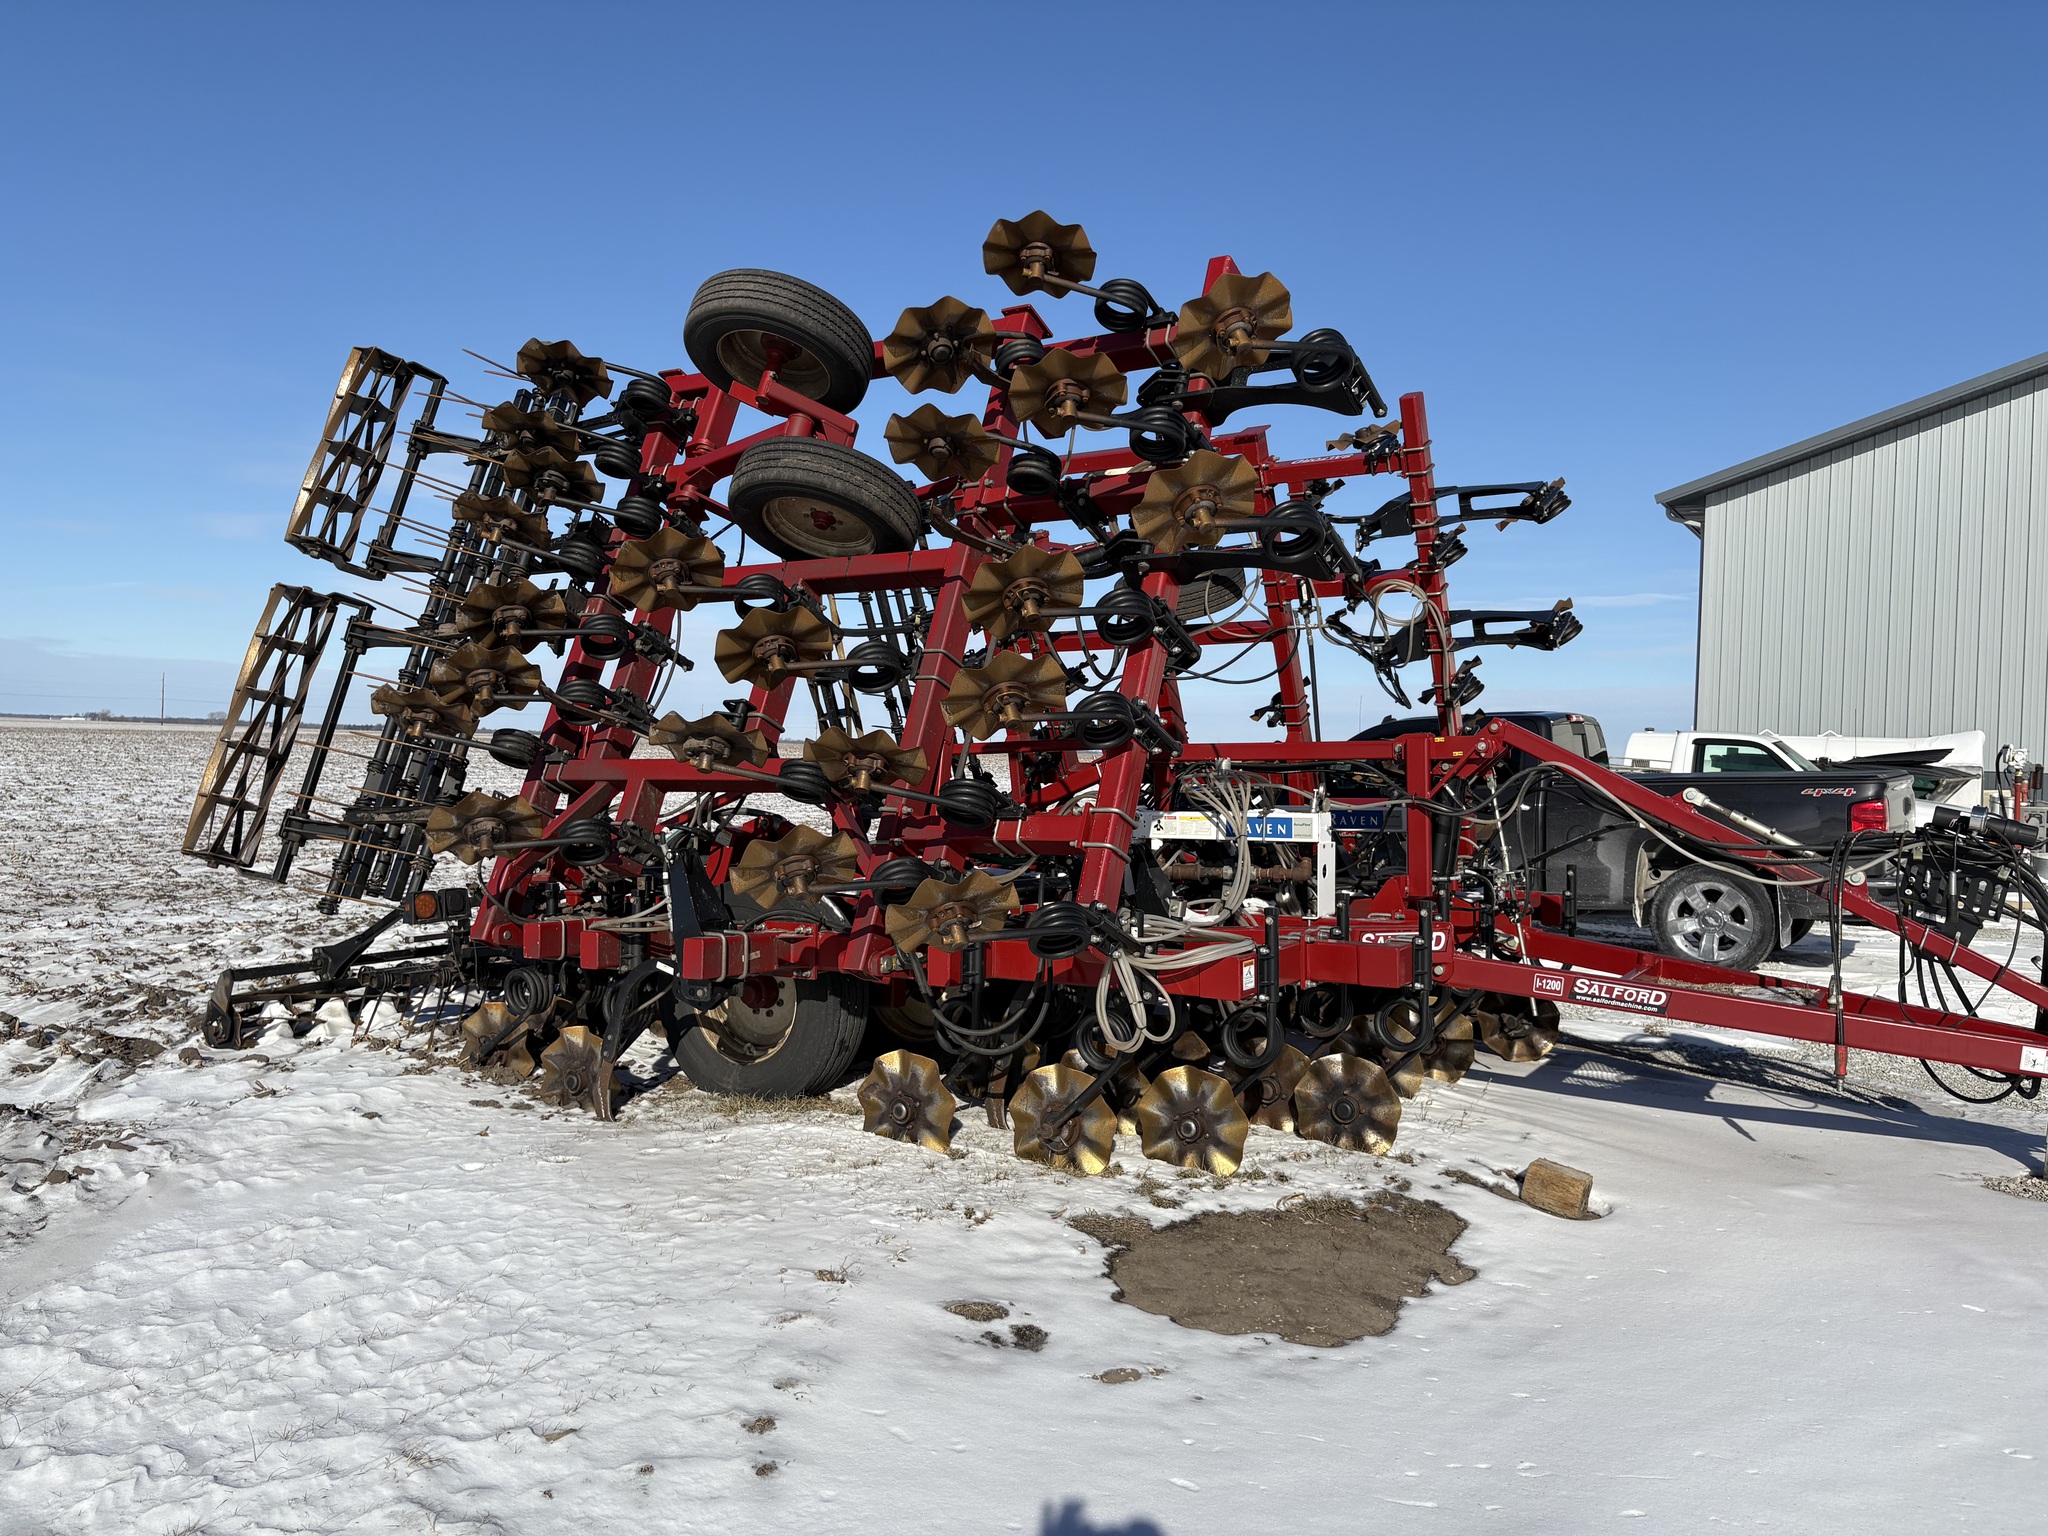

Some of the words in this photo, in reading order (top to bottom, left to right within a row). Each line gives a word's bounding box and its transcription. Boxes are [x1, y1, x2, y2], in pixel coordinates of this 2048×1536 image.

[1331, 813, 1378, 826] RAVEN
[1246, 822, 1287, 835] AVEN
[1536, 977, 1561, 991] I-1200
[1573, 979, 1667, 1006] SALFORD
